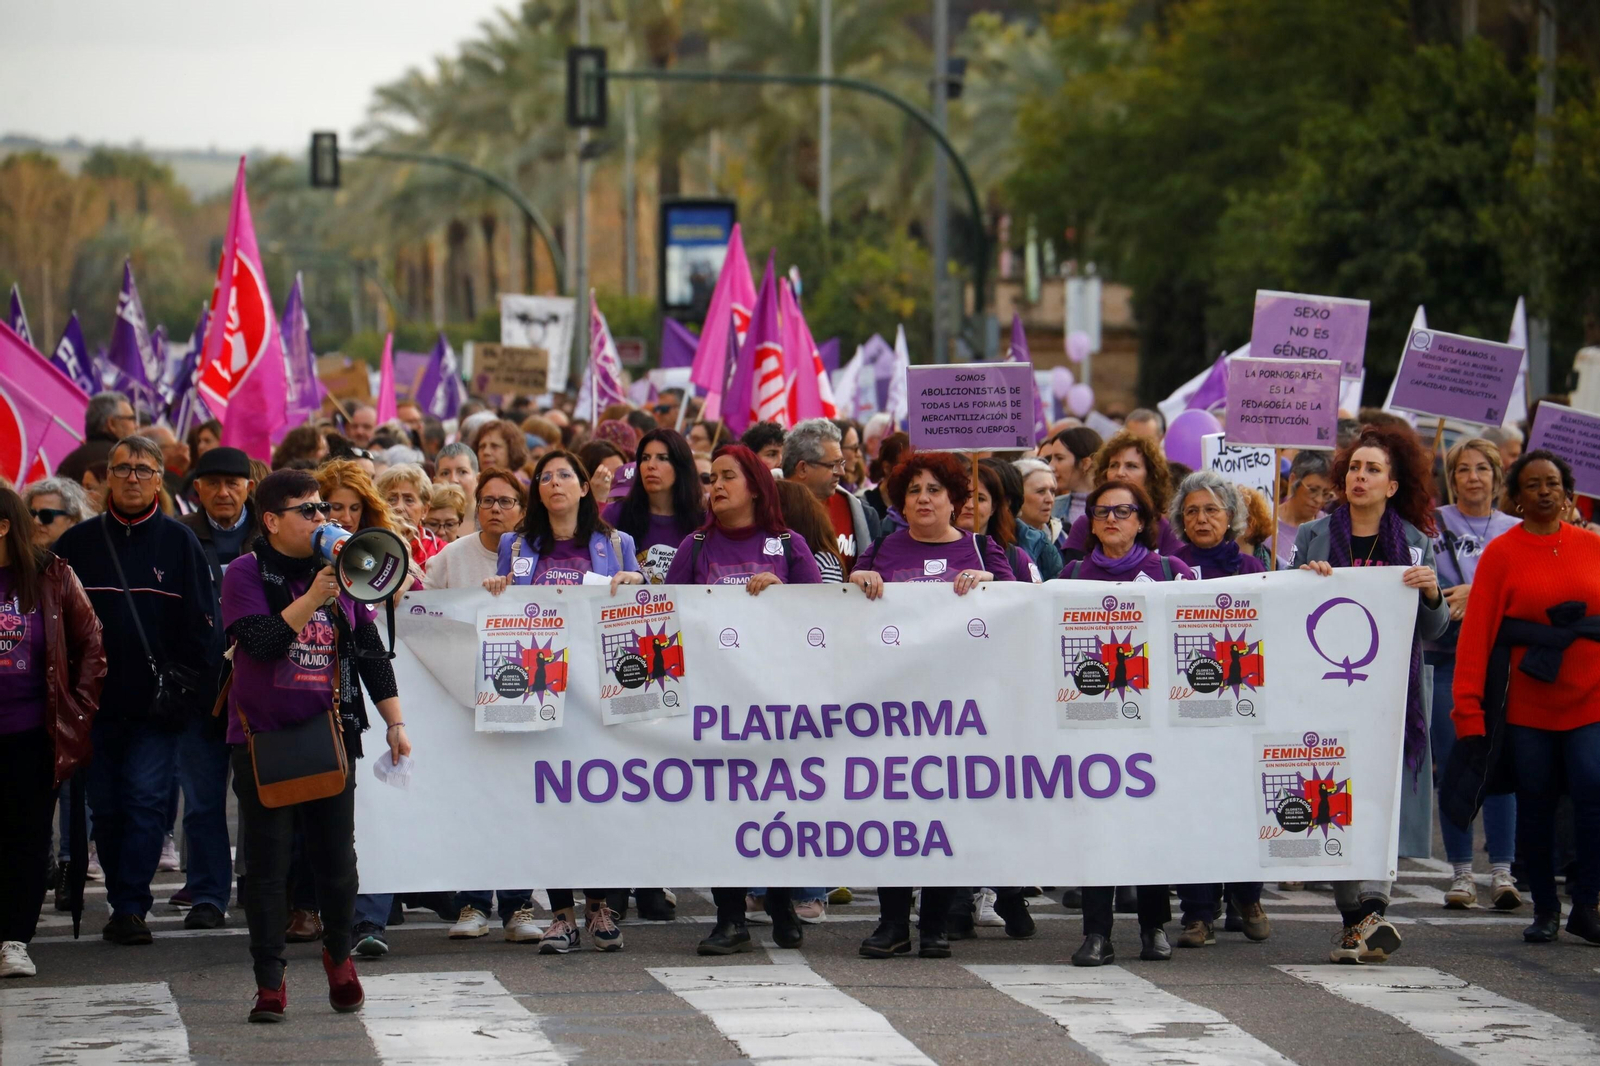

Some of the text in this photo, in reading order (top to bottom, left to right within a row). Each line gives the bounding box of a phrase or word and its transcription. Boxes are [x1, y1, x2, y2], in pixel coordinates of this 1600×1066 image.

[1294, 306, 1330, 320] SEXO
[1290, 326, 1330, 339] NO ES
[1273, 341, 1332, 360] GÉNERO.
[1438, 344, 1488, 359] RECLAMAMOS
[955, 374, 986, 382] SOMOS
[1259, 370, 1322, 380] PORNOGRAFÍA
[1270, 386, 1294, 394] ES LA
[1410, 379, 1446, 391] CAPACIDAD
[921, 386, 1020, 396] ABOLICIONISTAS DE
[972, 400, 1007, 408] FORMAS
[1242, 399, 1322, 410] PEDAGOGÍA DE LA
[922, 412, 1007, 422] MERCANTILIZACIÓN
[1240, 415, 1311, 426] PROSTITUCIÓN.
[925, 426, 1018, 434] NUESTROS CUERPOS.
[1212, 452, 1270, 472] MONTERO
[546, 571, 579, 580] SOMOS
[652, 594, 667, 602] 8M
[601, 601, 674, 618] FEMINISMO
[1176, 608, 1257, 621] FEMINISMO
[1063, 611, 1142, 622] FEMINISMO
[486, 618, 564, 629] FEMINISMO
[289, 650, 328, 666] DEL MUNDO
[693, 699, 987, 741] PLATAFORMA
[1322, 738, 1337, 746] 8M
[1263, 746, 1344, 759] FEMINISMO
[534, 752, 1156, 804] NOSOTRAS DECIDIMOS
[735, 811, 953, 858] CÓRDOBA
